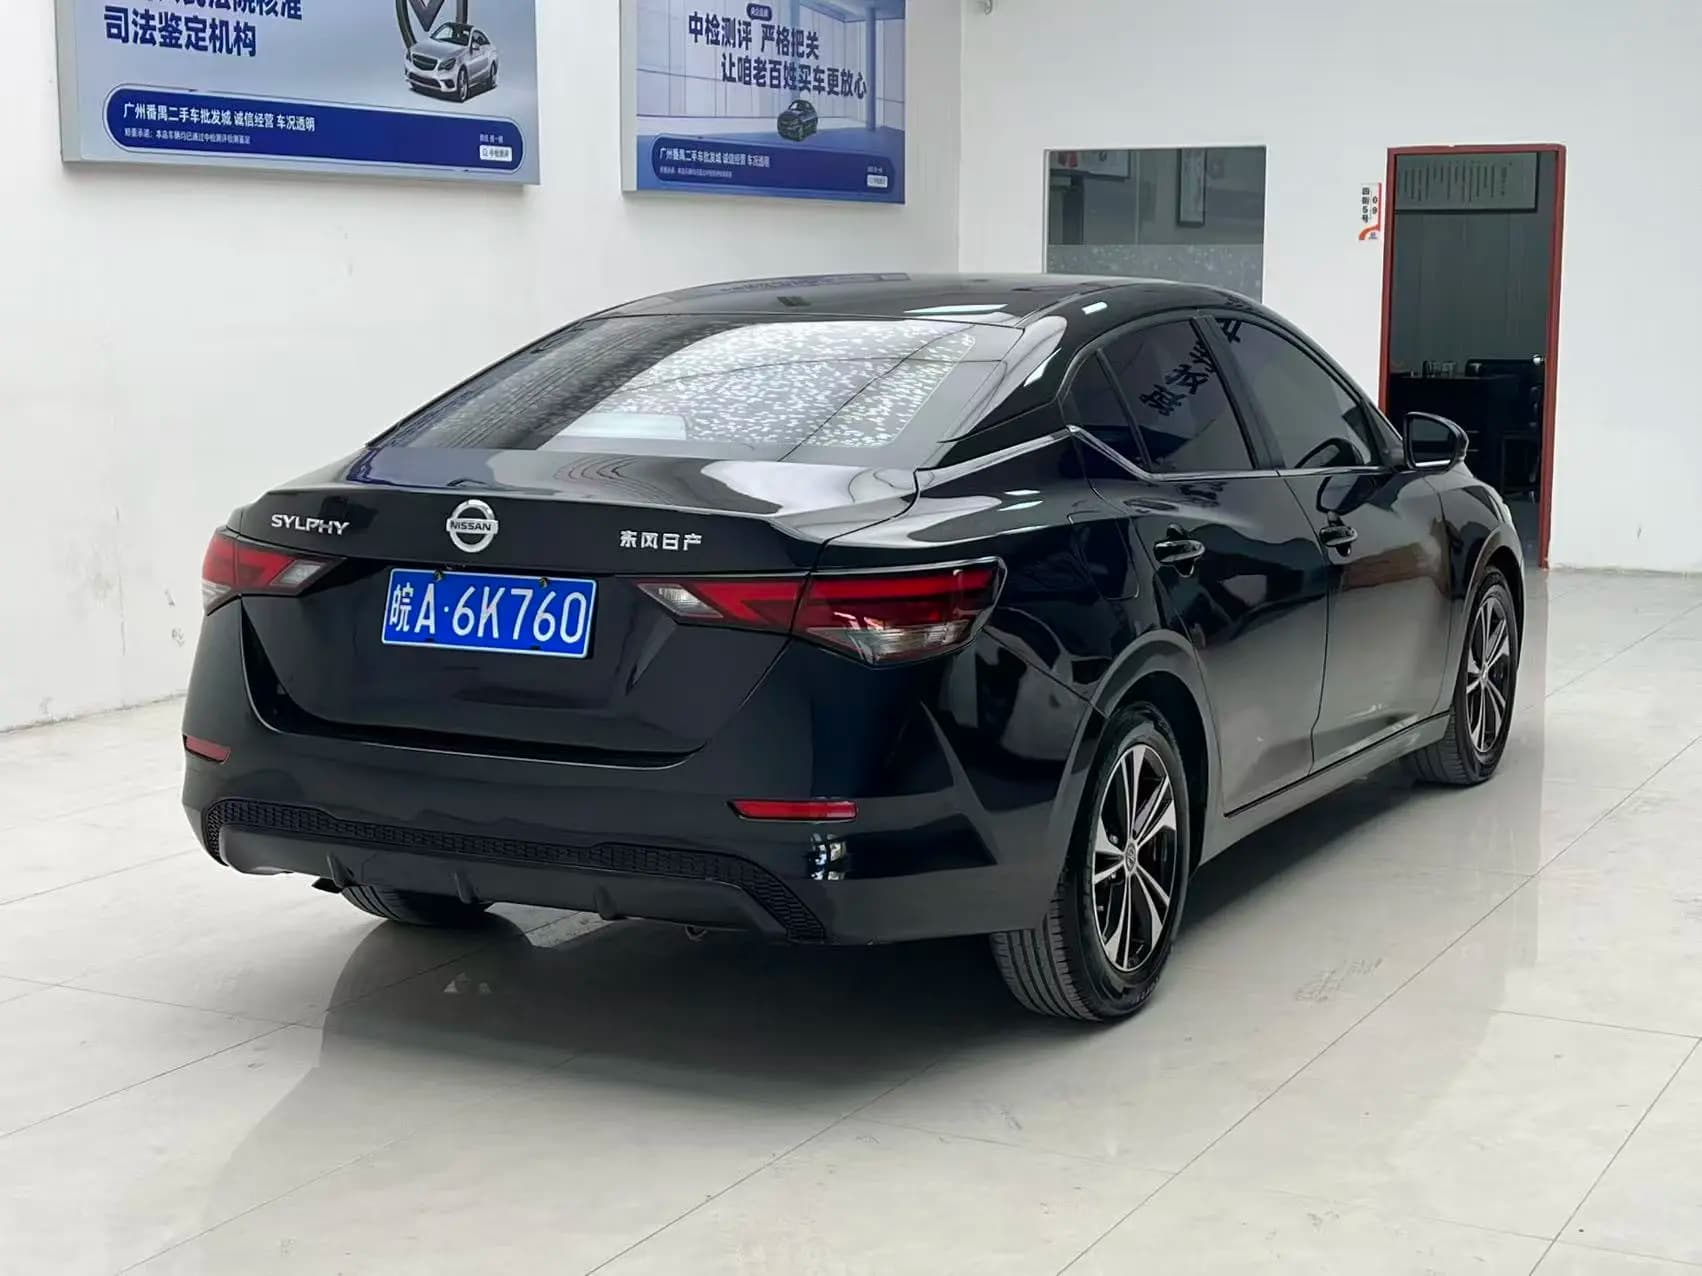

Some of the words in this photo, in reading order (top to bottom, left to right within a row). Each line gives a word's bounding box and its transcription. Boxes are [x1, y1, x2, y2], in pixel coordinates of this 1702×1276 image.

[104, 5, 257, 57] 司法鉴定机构
[688, 11, 752, 51] 中检测评
[761, 23, 819, 60] 严格把关
[721, 52, 867, 99] 让咱老百姓买车更放心
[123, 102, 232, 126] 广州番禺二手车批发城
[234, 111, 274, 129] 诚信经营
[276, 114, 316, 132] 车况透明
[271, 514, 350, 536] SYLPHY
[449, 519, 492, 532] NISSAN
[620, 530, 702, 551] 东风日产
[389, 582, 587, 644] 皖A·6K760
